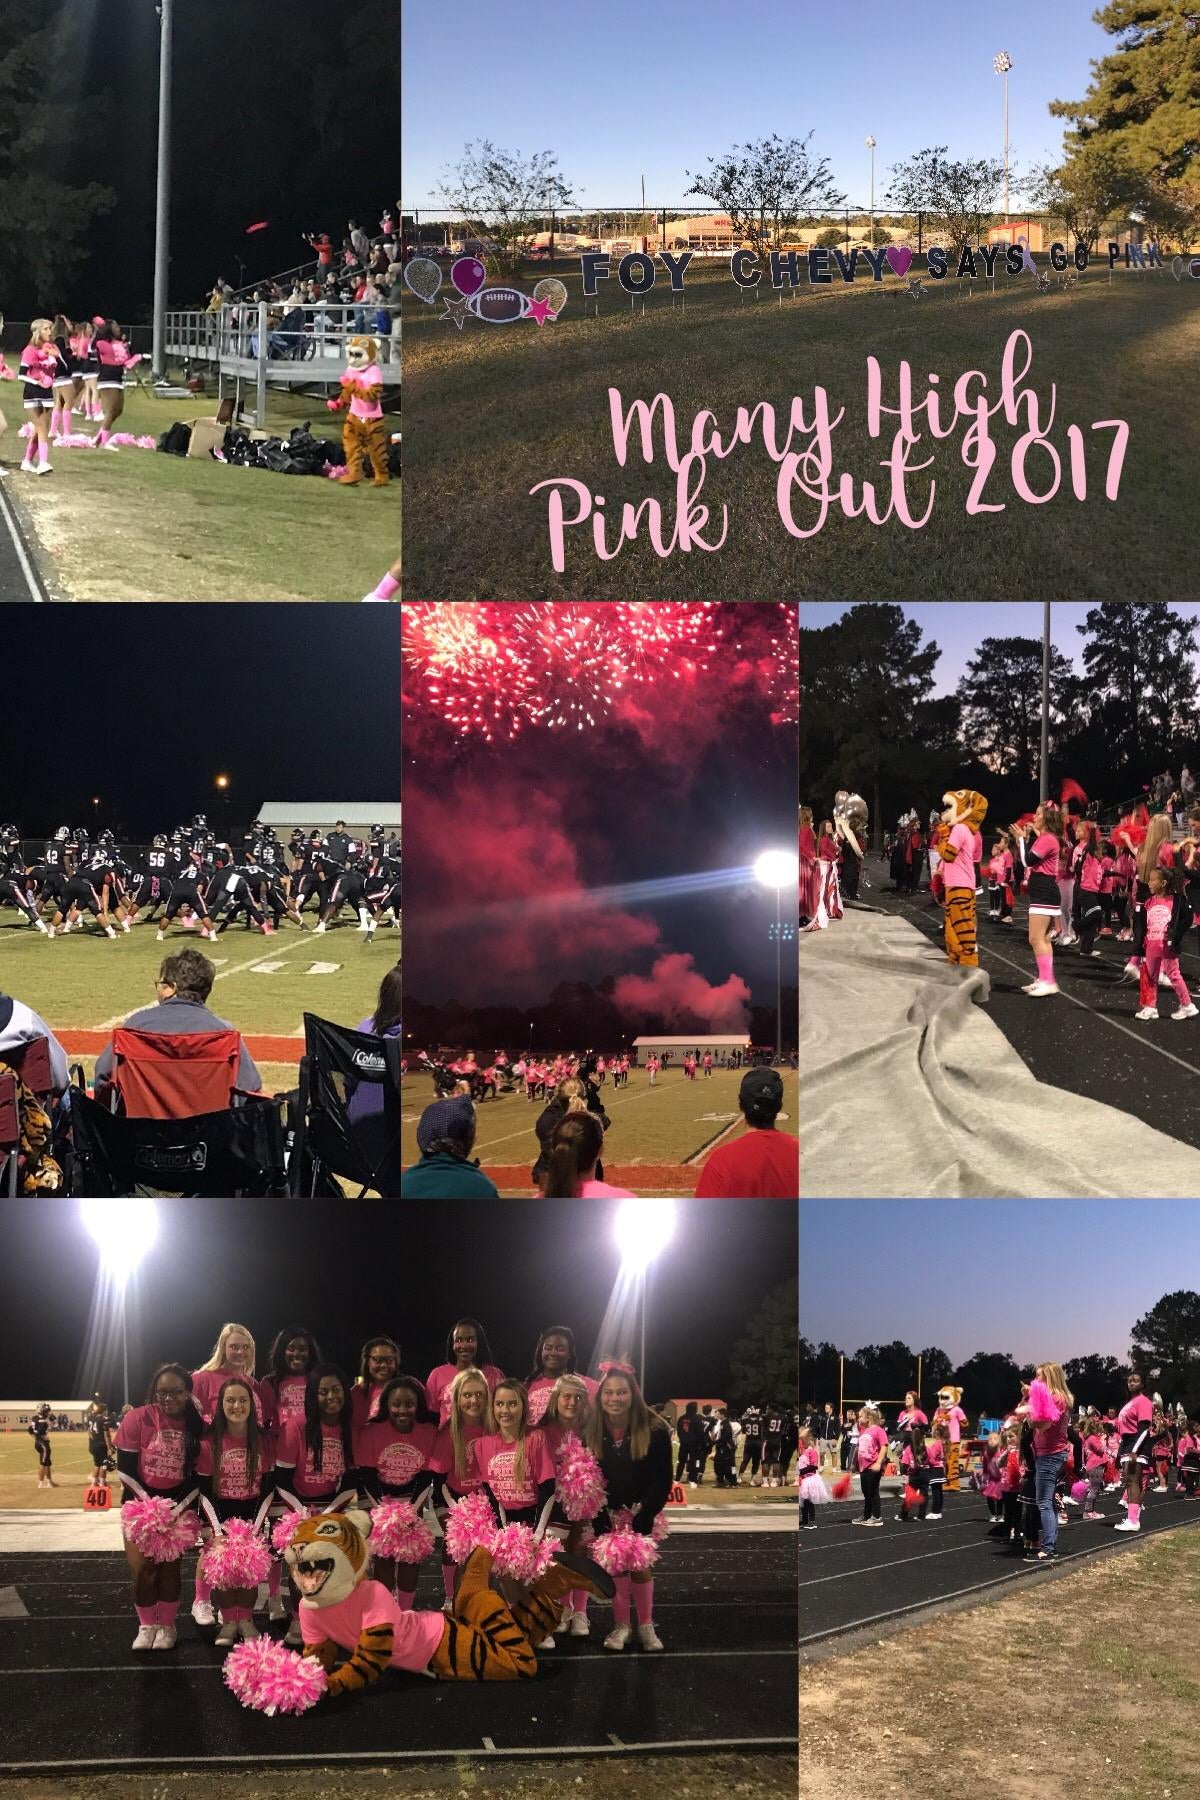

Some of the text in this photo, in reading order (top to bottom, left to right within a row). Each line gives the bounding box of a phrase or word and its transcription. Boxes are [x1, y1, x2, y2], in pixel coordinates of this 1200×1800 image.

[581, 249, 695, 296] FOY
[731, 248, 888, 288] CHEVY
[927, 244, 1024, 280] SAYS
[1050, 242, 1090, 273] GO
[46, 849, 58, 865] 42
[149, 852, 166, 867] 56
[745, 1424, 759, 1436] 39
[769, 1419, 781, 1432] 91
[87, 1489, 107, 1506] 40
